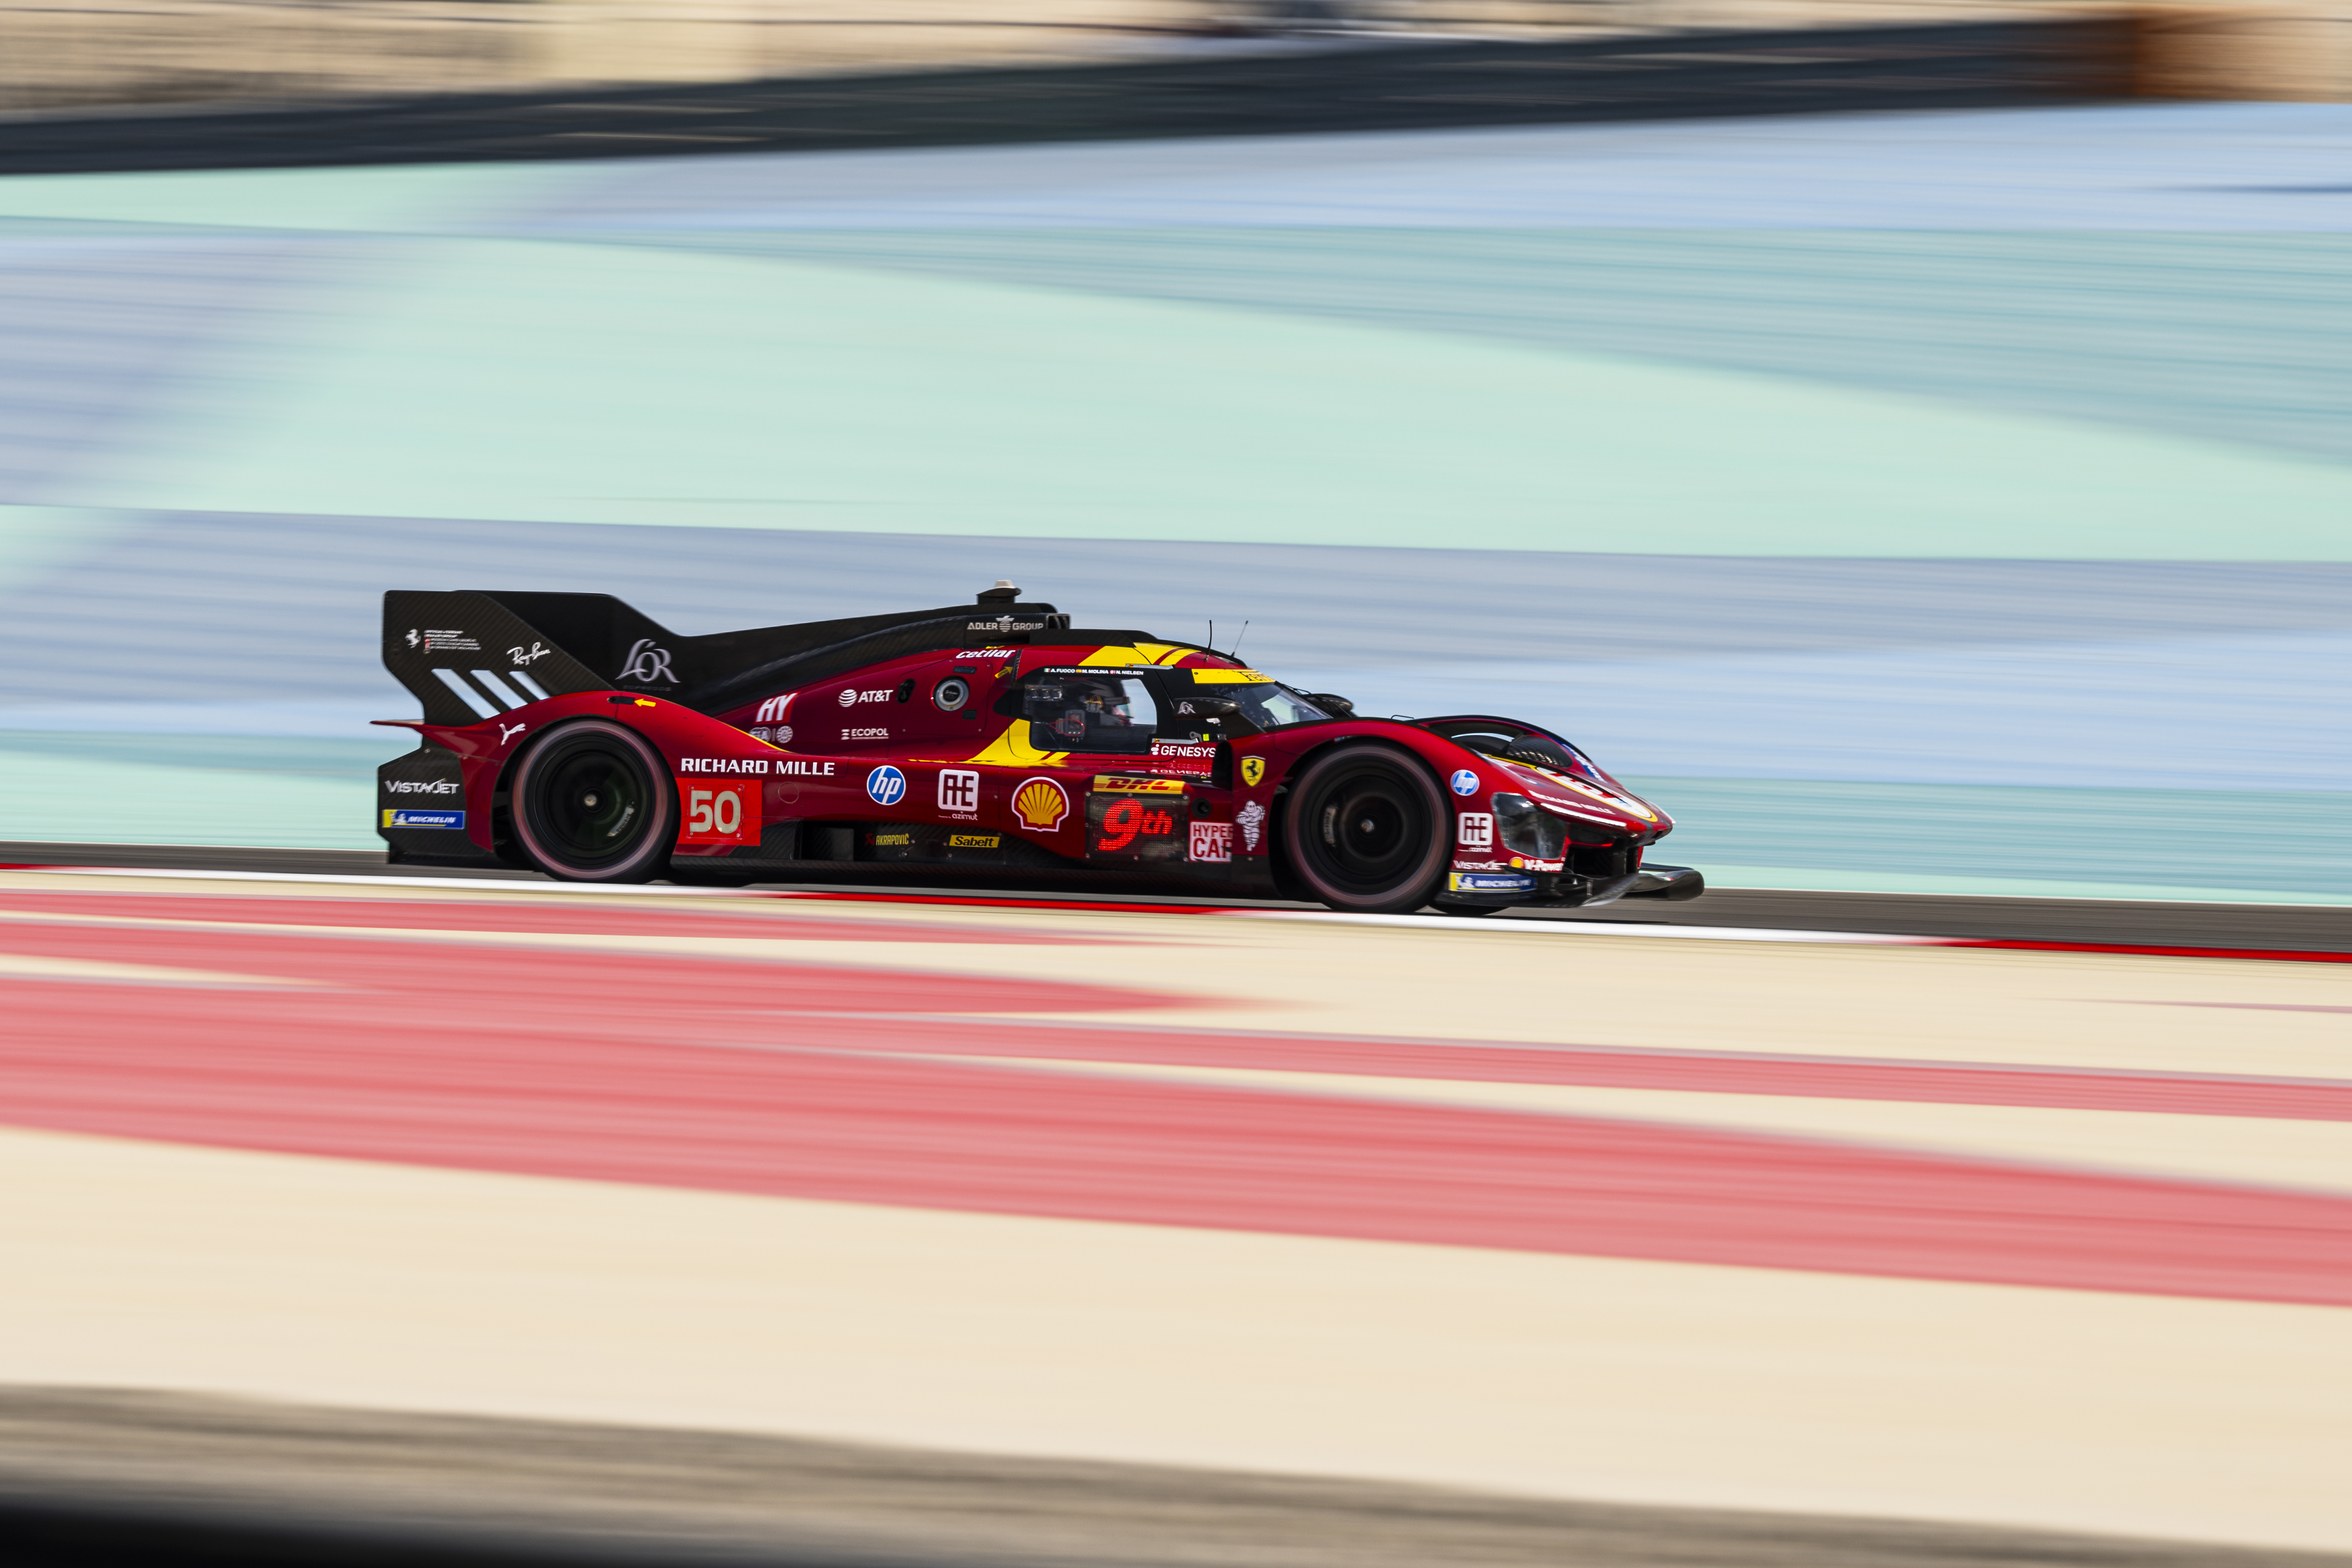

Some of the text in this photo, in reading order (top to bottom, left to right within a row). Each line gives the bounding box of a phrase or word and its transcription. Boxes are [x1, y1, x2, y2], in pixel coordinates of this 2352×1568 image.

[967, 622, 1044, 631] ADLER GROUP
[858, 690, 894, 703] AT&T
[851, 728, 889, 736] ECOPOL
[1161, 745, 1216, 758] GENESYS
[681, 758, 835, 776] RICHARD MILLE
[385, 778, 460, 794] VISTAJET
[1105, 777, 1170, 790] DHL
[690, 790, 741, 834] 50
[952, 811, 978, 820] azimut
[1098, 798, 1172, 851] 9th
[876, 833, 909, 845] AKRAPOVIČ
[955, 836, 994, 847] Sabelt
